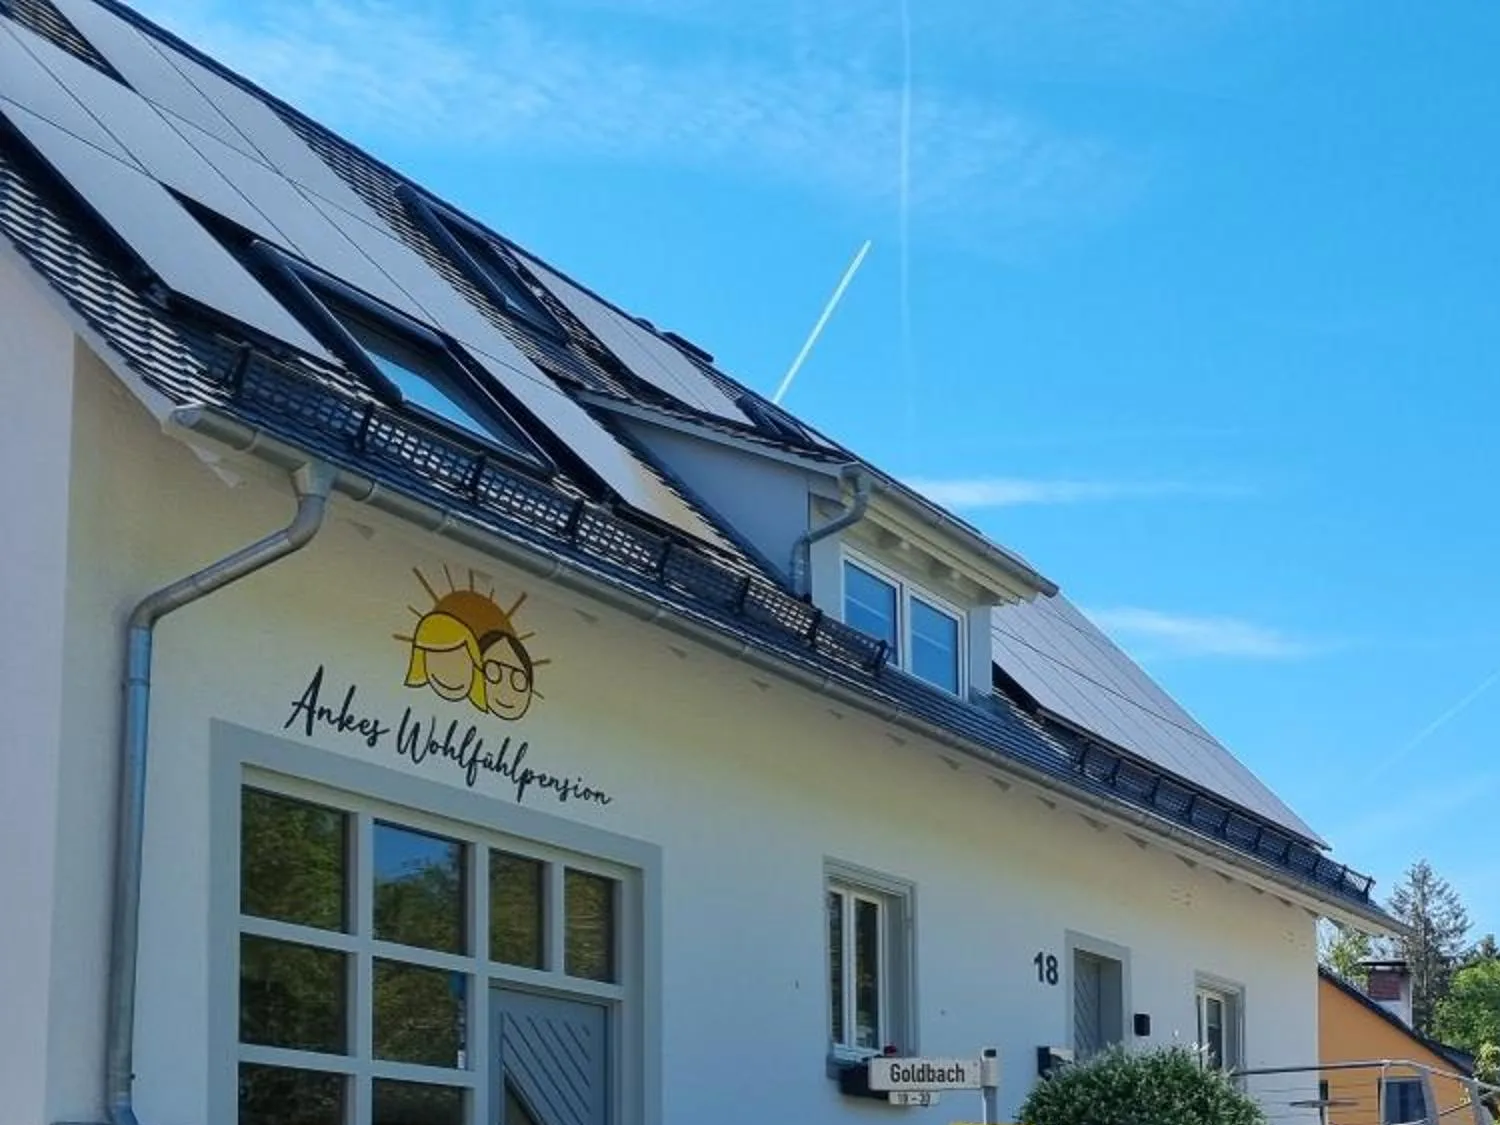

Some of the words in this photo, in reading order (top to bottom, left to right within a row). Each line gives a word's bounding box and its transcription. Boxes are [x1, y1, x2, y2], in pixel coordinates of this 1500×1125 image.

[285, 665, 390, 747] Ankes
[397, 707, 613, 805] Wohlfühlpension
[1034, 952, 1059, 985] 18
[890, 1063, 965, 1083] Goldbach
